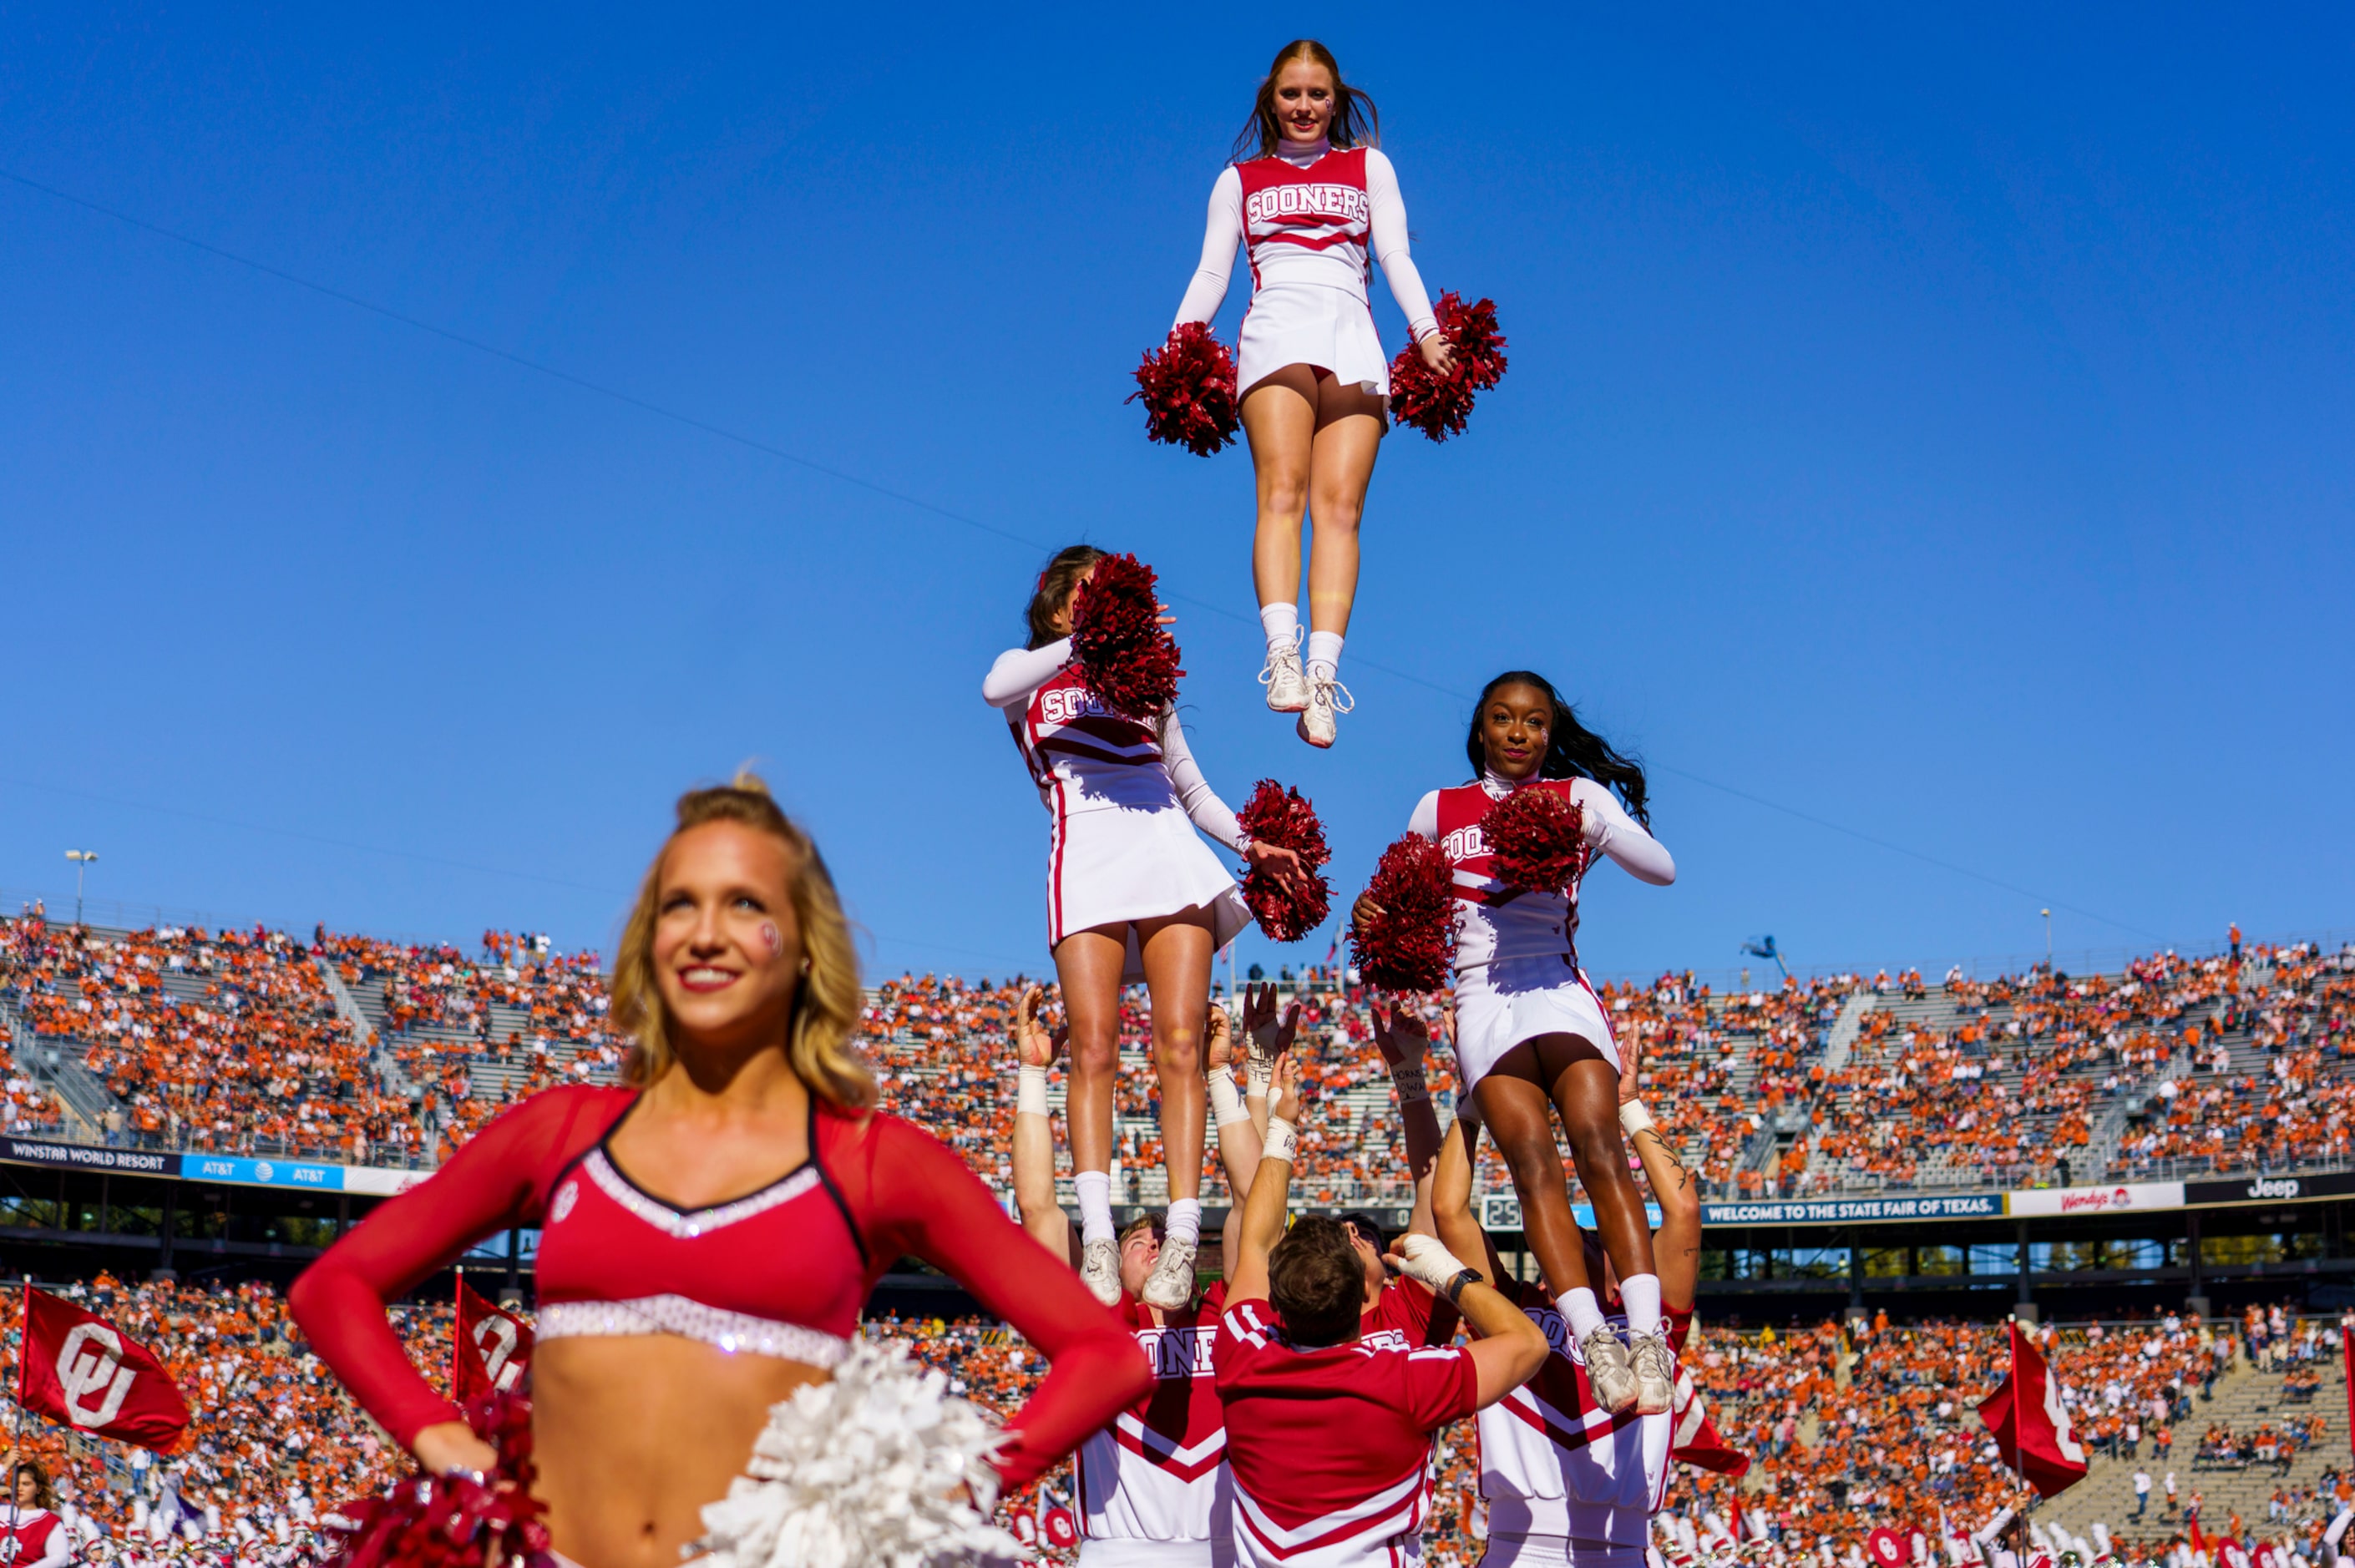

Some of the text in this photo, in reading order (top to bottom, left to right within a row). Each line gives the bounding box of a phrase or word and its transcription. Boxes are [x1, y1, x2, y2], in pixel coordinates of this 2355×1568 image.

[1247, 184, 1370, 225] SOONERS
[12, 1141, 165, 1171] WINSTAR WORLD RESORT
[203, 1161, 236, 1176] AT&T
[293, 1168, 326, 1183] AT&T
[2247, 1176, 2299, 1200] Jeep
[1489, 1201, 1519, 1225] 25
[1708, 1205, 1782, 1221] WELCOME
[1784, 1205, 1806, 1220] TO
[1806, 1204, 1837, 1219] THE
[1838, 1202, 1881, 1218] STATE
[1883, 1201, 1917, 1216] FAIR
[1918, 1200, 1941, 1214] OF
[55, 1322, 138, 1429] OU
